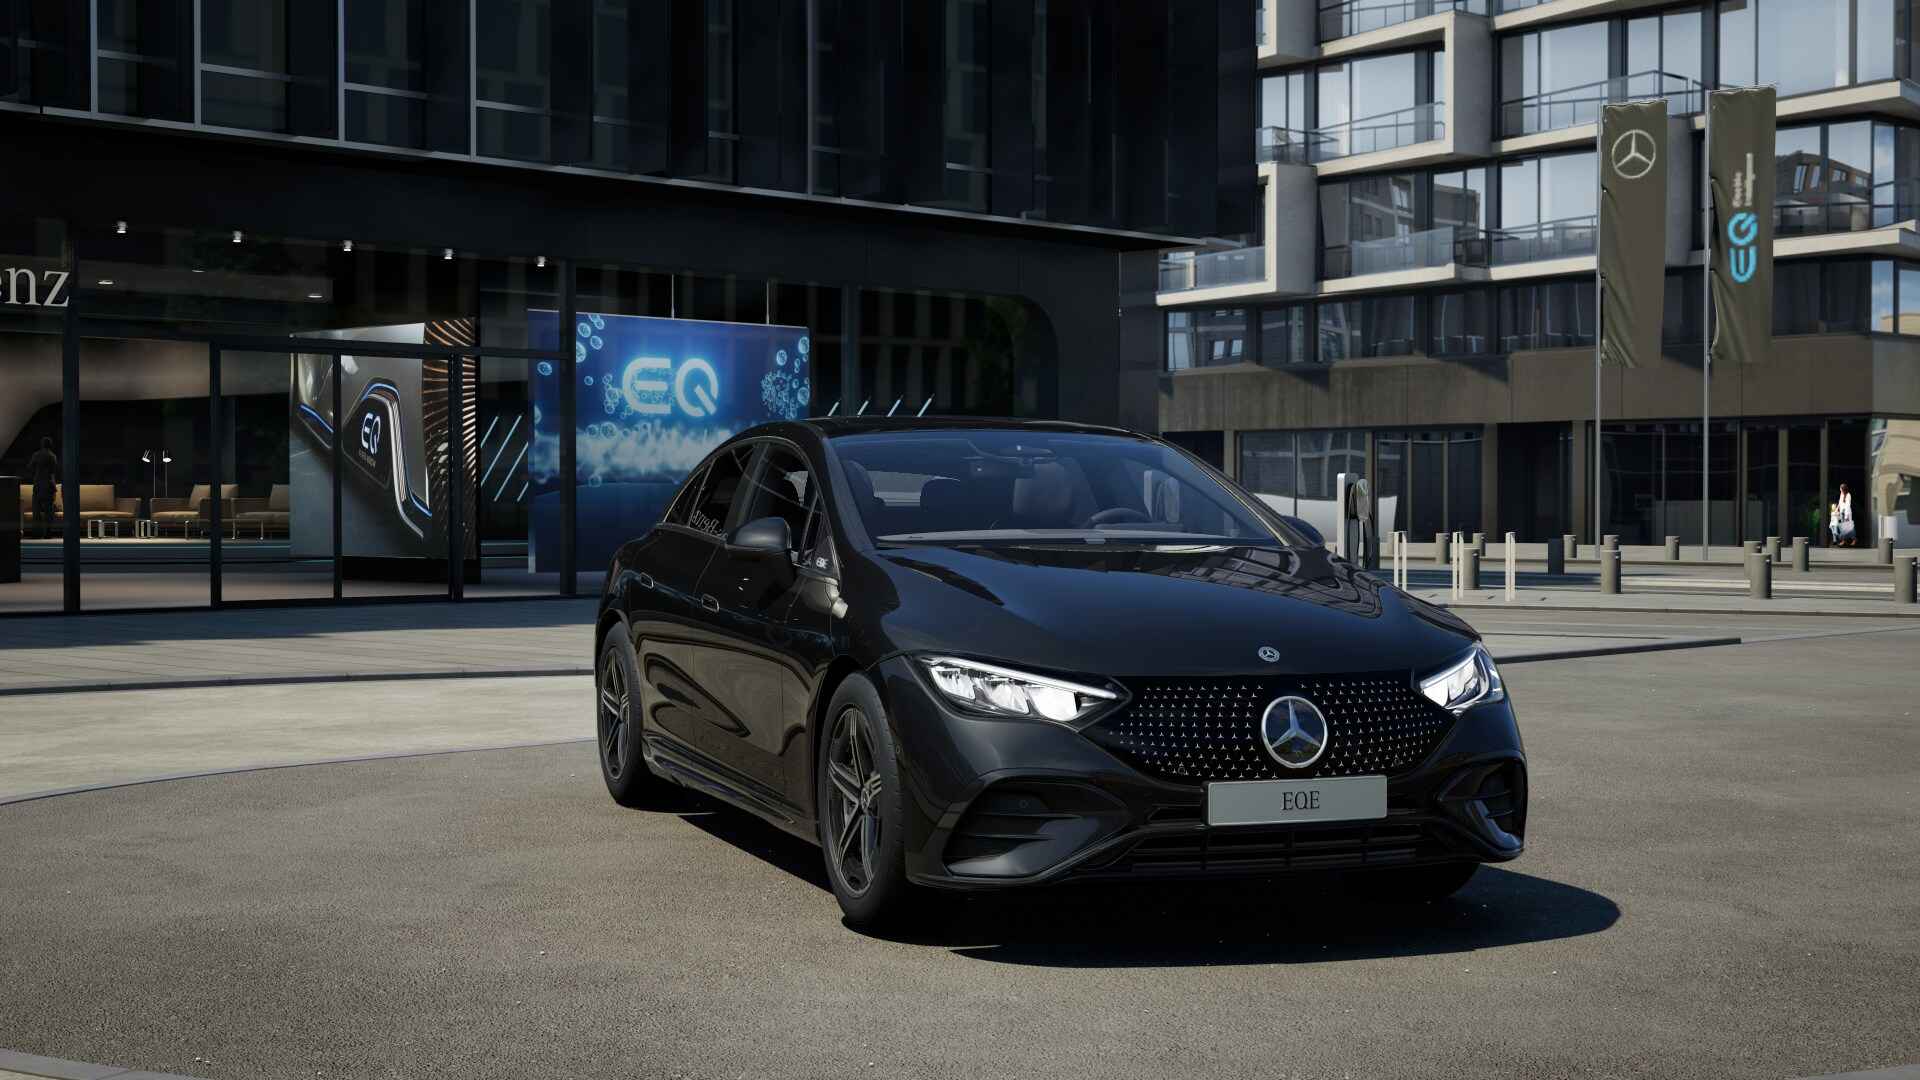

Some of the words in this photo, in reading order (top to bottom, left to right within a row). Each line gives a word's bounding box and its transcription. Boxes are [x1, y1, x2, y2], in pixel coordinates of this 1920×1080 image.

[1728, 212, 1758, 283] EQ
[0, 267, 70, 307] nz
[623, 357, 719, 417] EQ
[361, 412, 381, 455] EQ
[1282, 790, 1321, 811] EQE
